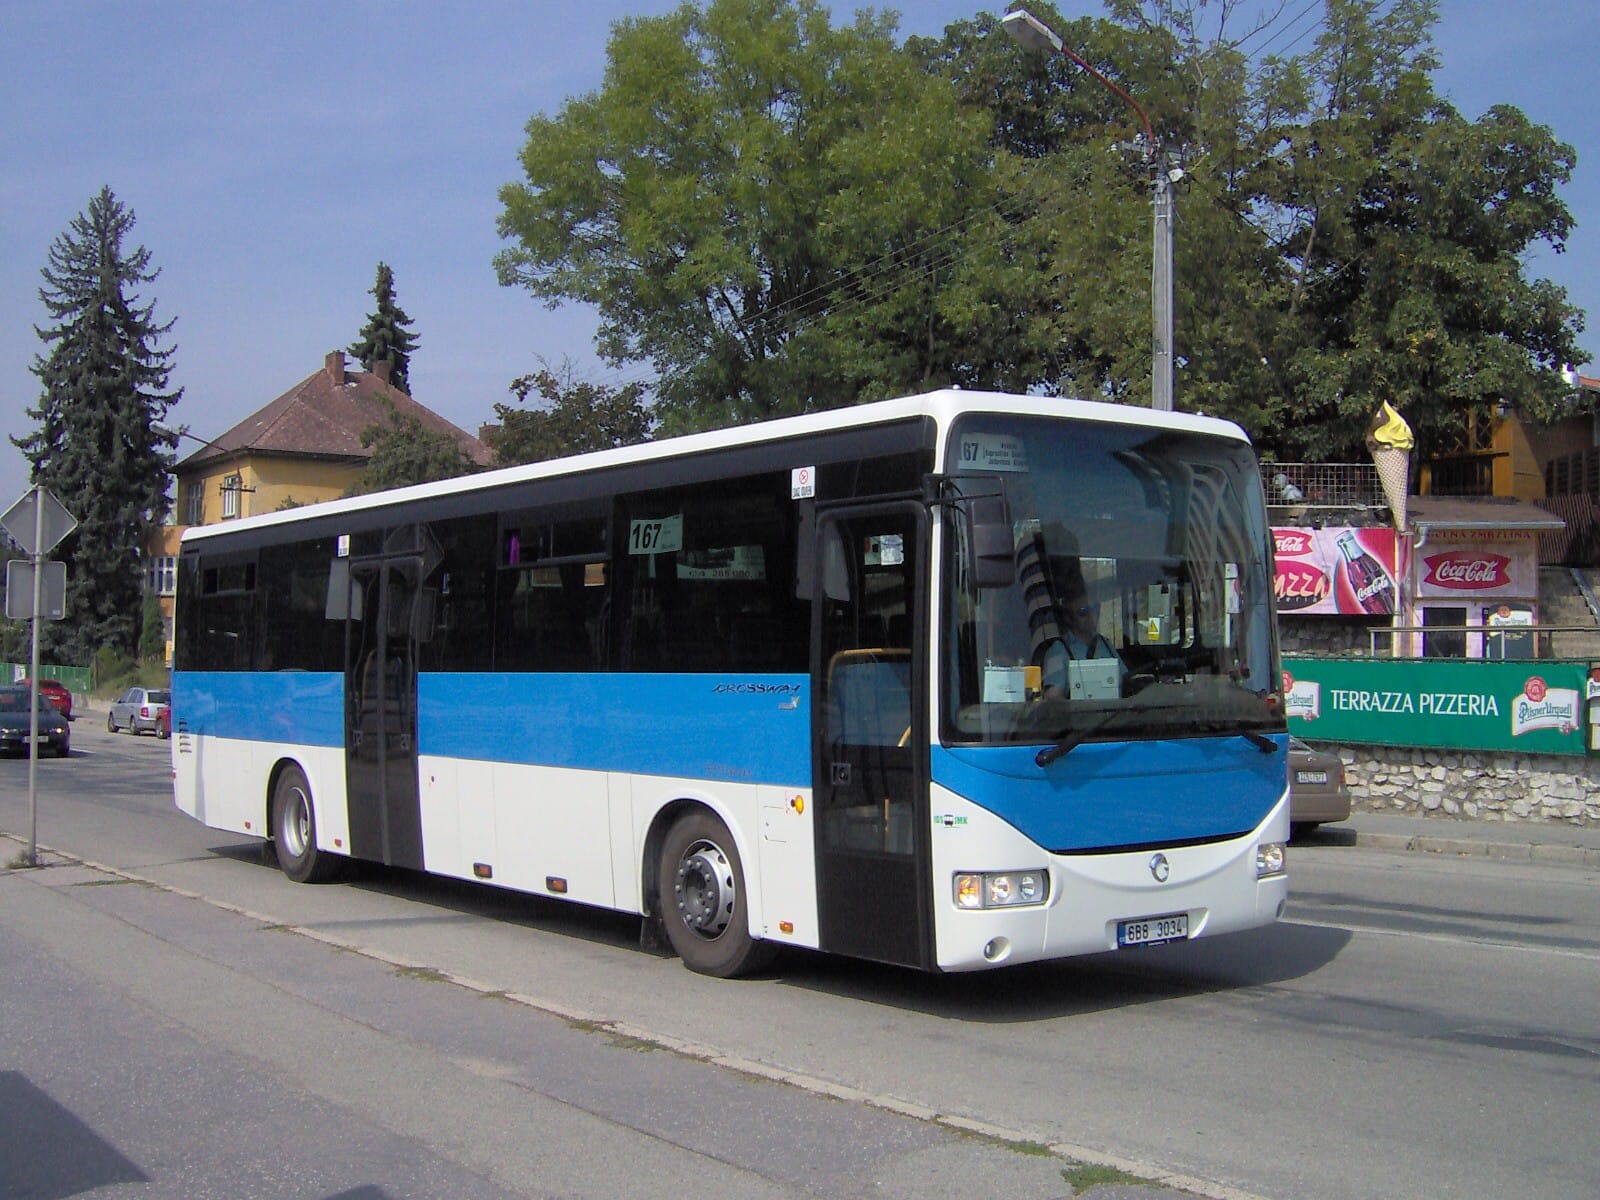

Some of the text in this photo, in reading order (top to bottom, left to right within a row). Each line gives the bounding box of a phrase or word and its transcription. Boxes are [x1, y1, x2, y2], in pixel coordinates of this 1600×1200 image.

[632, 523, 661, 549] 167
[1435, 560, 1499, 582] Coca-Cola
[1357, 574, 1389, 602] Coca-Cola
[712, 683, 800, 695] CROSSWAY
[1330, 690, 1499, 716] TERRAZZA PIZZERIA
[1518, 702, 1572, 724] Pilsner Urquell
[1128, 919, 1182, 941] 6B8 3034
